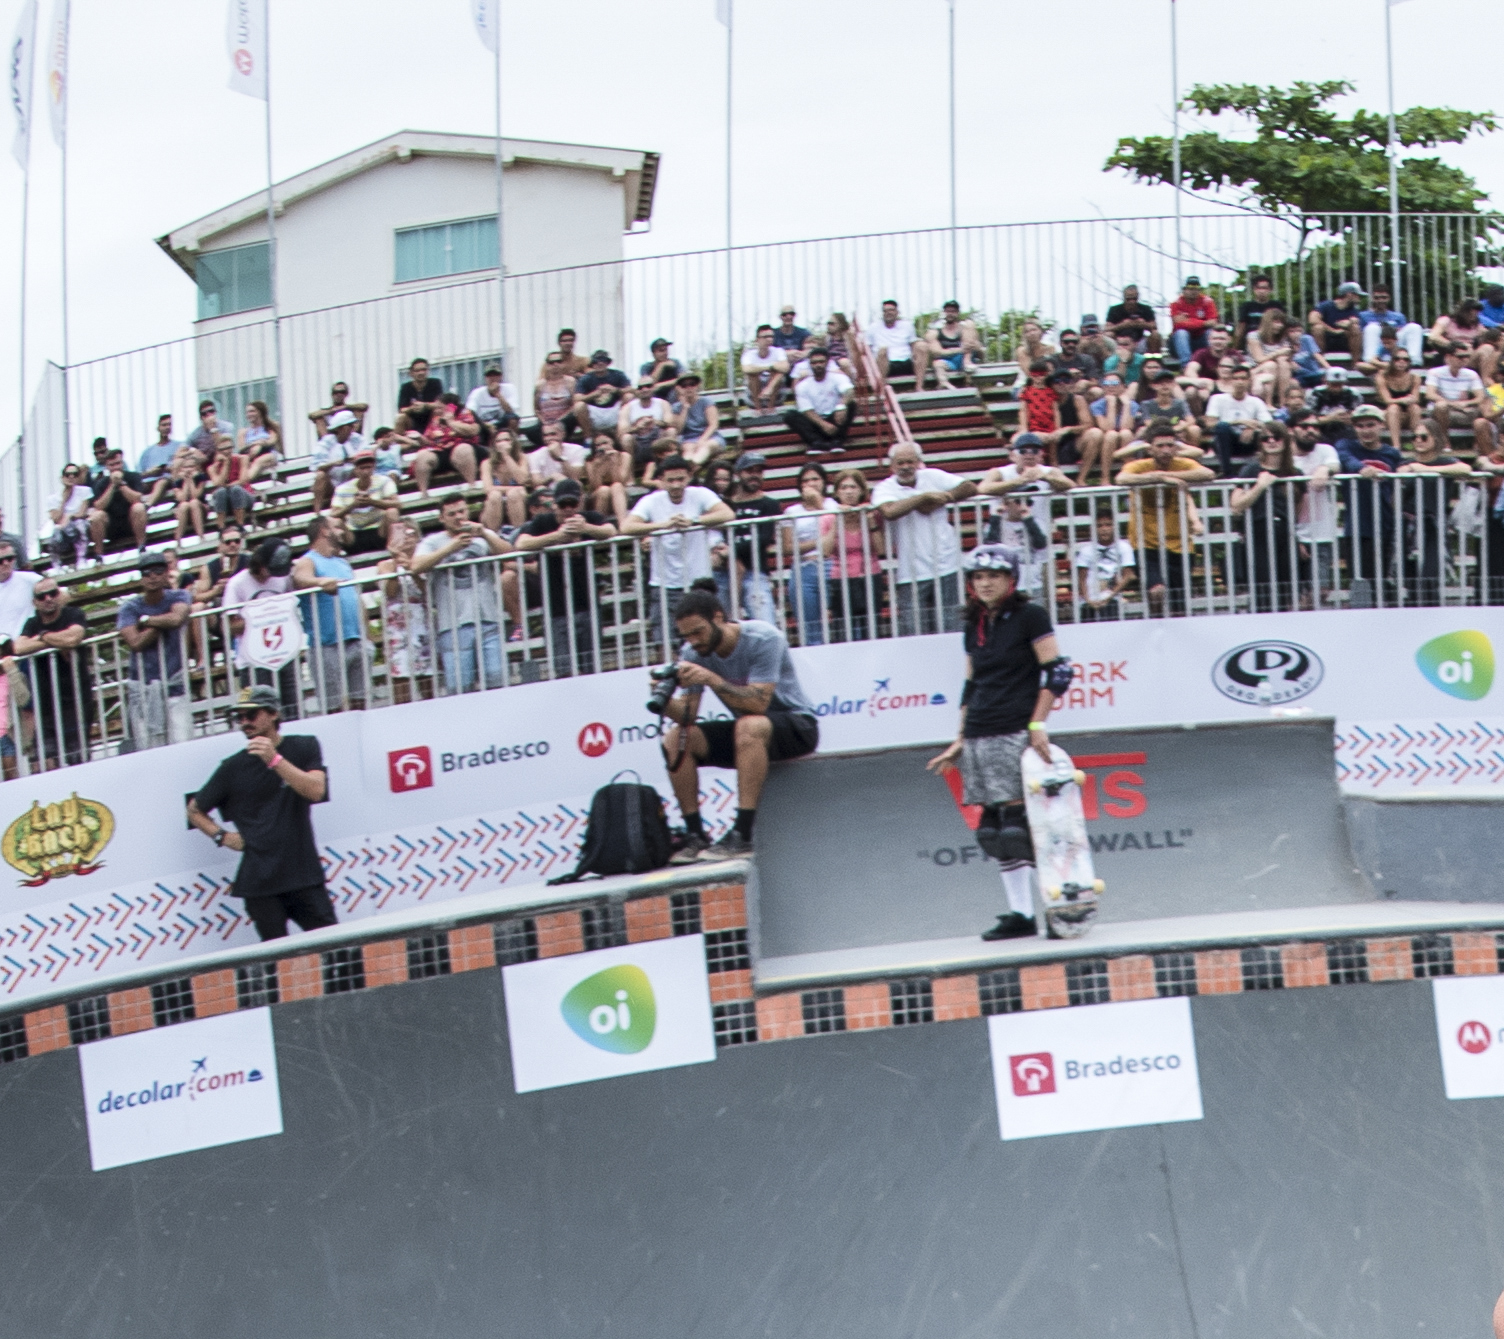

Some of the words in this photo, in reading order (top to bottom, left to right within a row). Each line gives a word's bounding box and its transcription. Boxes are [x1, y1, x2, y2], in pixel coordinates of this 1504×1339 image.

[1071, 660, 1128, 684] ARK
[1438, 650, 1474, 682] oi
[440, 738, 550, 774] Bradesco
[588, 989, 630, 1034] oi
[1064, 1051, 1181, 1081] Bradesco
